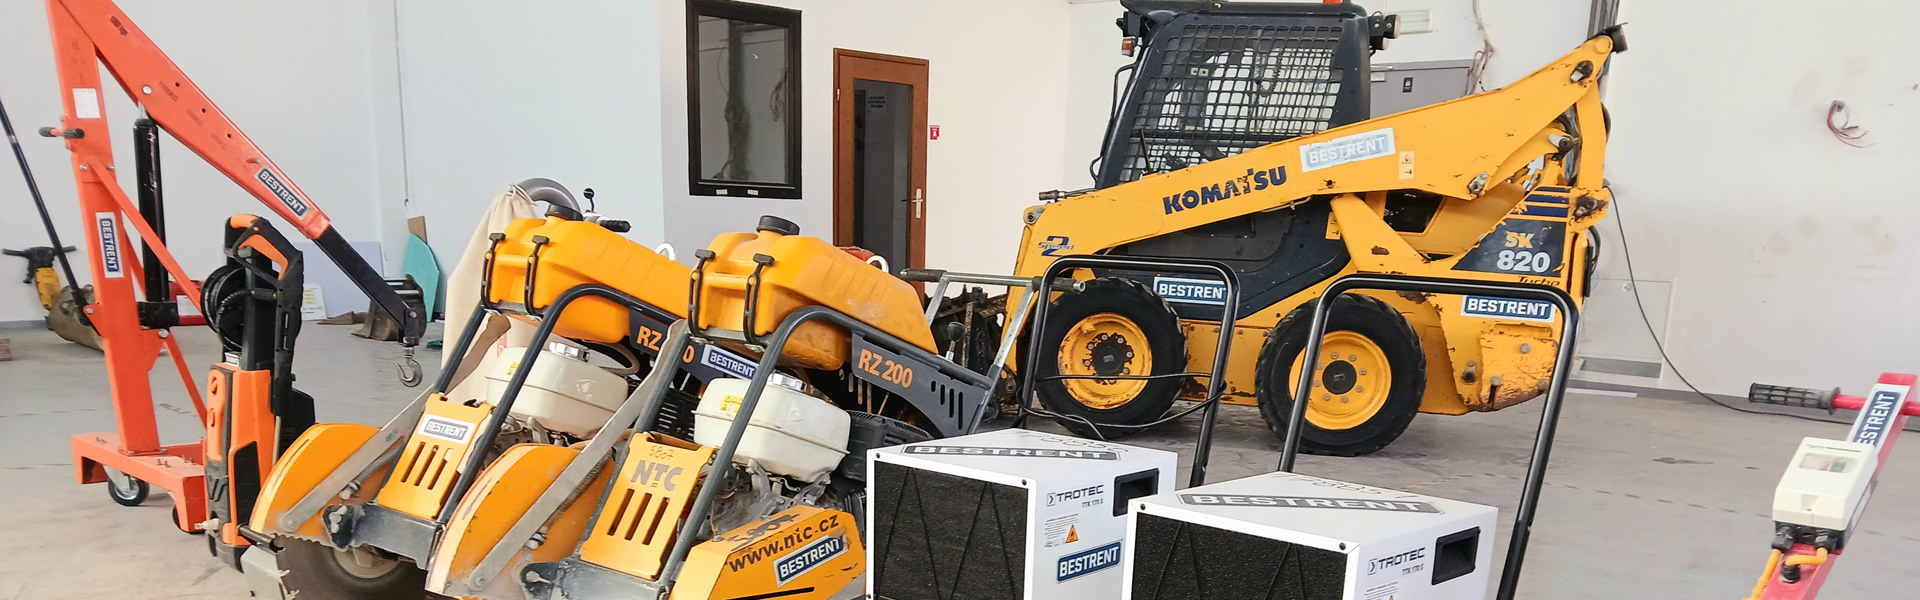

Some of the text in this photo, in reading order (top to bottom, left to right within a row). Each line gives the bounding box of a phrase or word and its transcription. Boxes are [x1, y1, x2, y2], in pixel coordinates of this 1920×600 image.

[1309, 134, 1387, 163] BESTRENT
[259, 170, 305, 215] BESTRENT
[1162, 166, 1287, 215] KOMATSU
[101, 219, 118, 272] BESTRENT
[1504, 230, 1535, 248] SK
[1497, 250, 1550, 272] 820
[1159, 282, 1226, 300] BESTREN
[1518, 275, 1560, 286] Turbo
[1467, 298, 1550, 316] BESTRENT
[636, 325, 663, 351] RZ
[710, 352, 757, 377] BESTRENT
[858, 348, 913, 388] RZ 200
[1857, 393, 1896, 446] ESTRENT
[913, 446, 1108, 459] BESTRENT
[631, 460, 684, 491] NTC
[1056, 485, 1104, 502] TROTEC
[1191, 495, 1421, 511] BESTRENT
[779, 537, 841, 578] BESTRENT
[1059, 546, 1120, 577] BESTRENT
[1378, 547, 1426, 569] TROTEC
